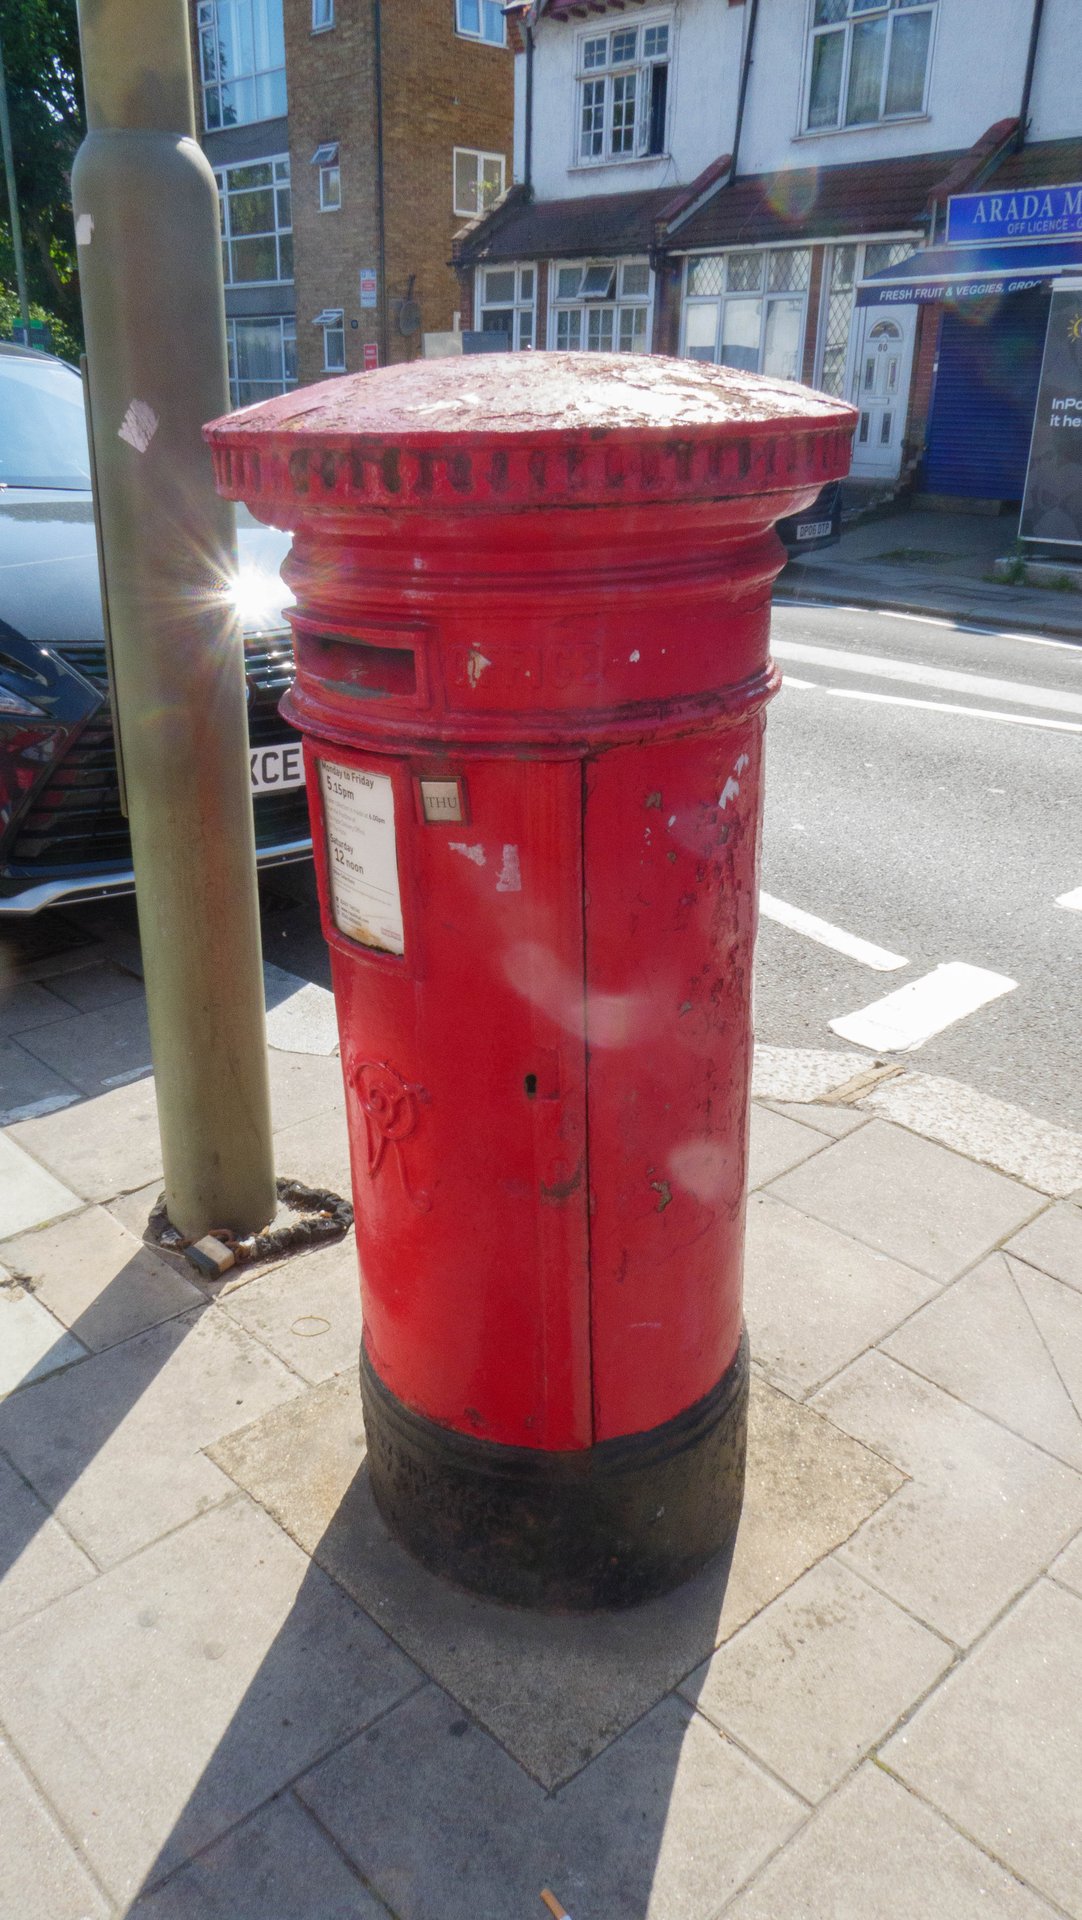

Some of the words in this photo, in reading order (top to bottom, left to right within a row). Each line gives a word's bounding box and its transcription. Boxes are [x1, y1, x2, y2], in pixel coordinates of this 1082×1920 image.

[972, 193, 1054, 224] ARADA
[1063, 190, 1082, 215] M
[1007, 222, 1025, 234] OFF
[1027, 219, 1068, 233] LICENCE
[880, 289, 913, 301] FRESH
[914, 287, 945, 299] FRUIT
[945, 286, 954, 297] &
[1050, 414, 1061, 427] it
[321, 761, 343, 780] Monday
[343, 770, 350, 781] to
[352, 772, 374, 789] Friday
[326, 775, 354, 800] 5.15pm
[425, 796, 457, 808] THU
[329, 833, 354, 855] Saturday
[334, 847, 345, 865] 12
[346, 859, 364, 875] noon
